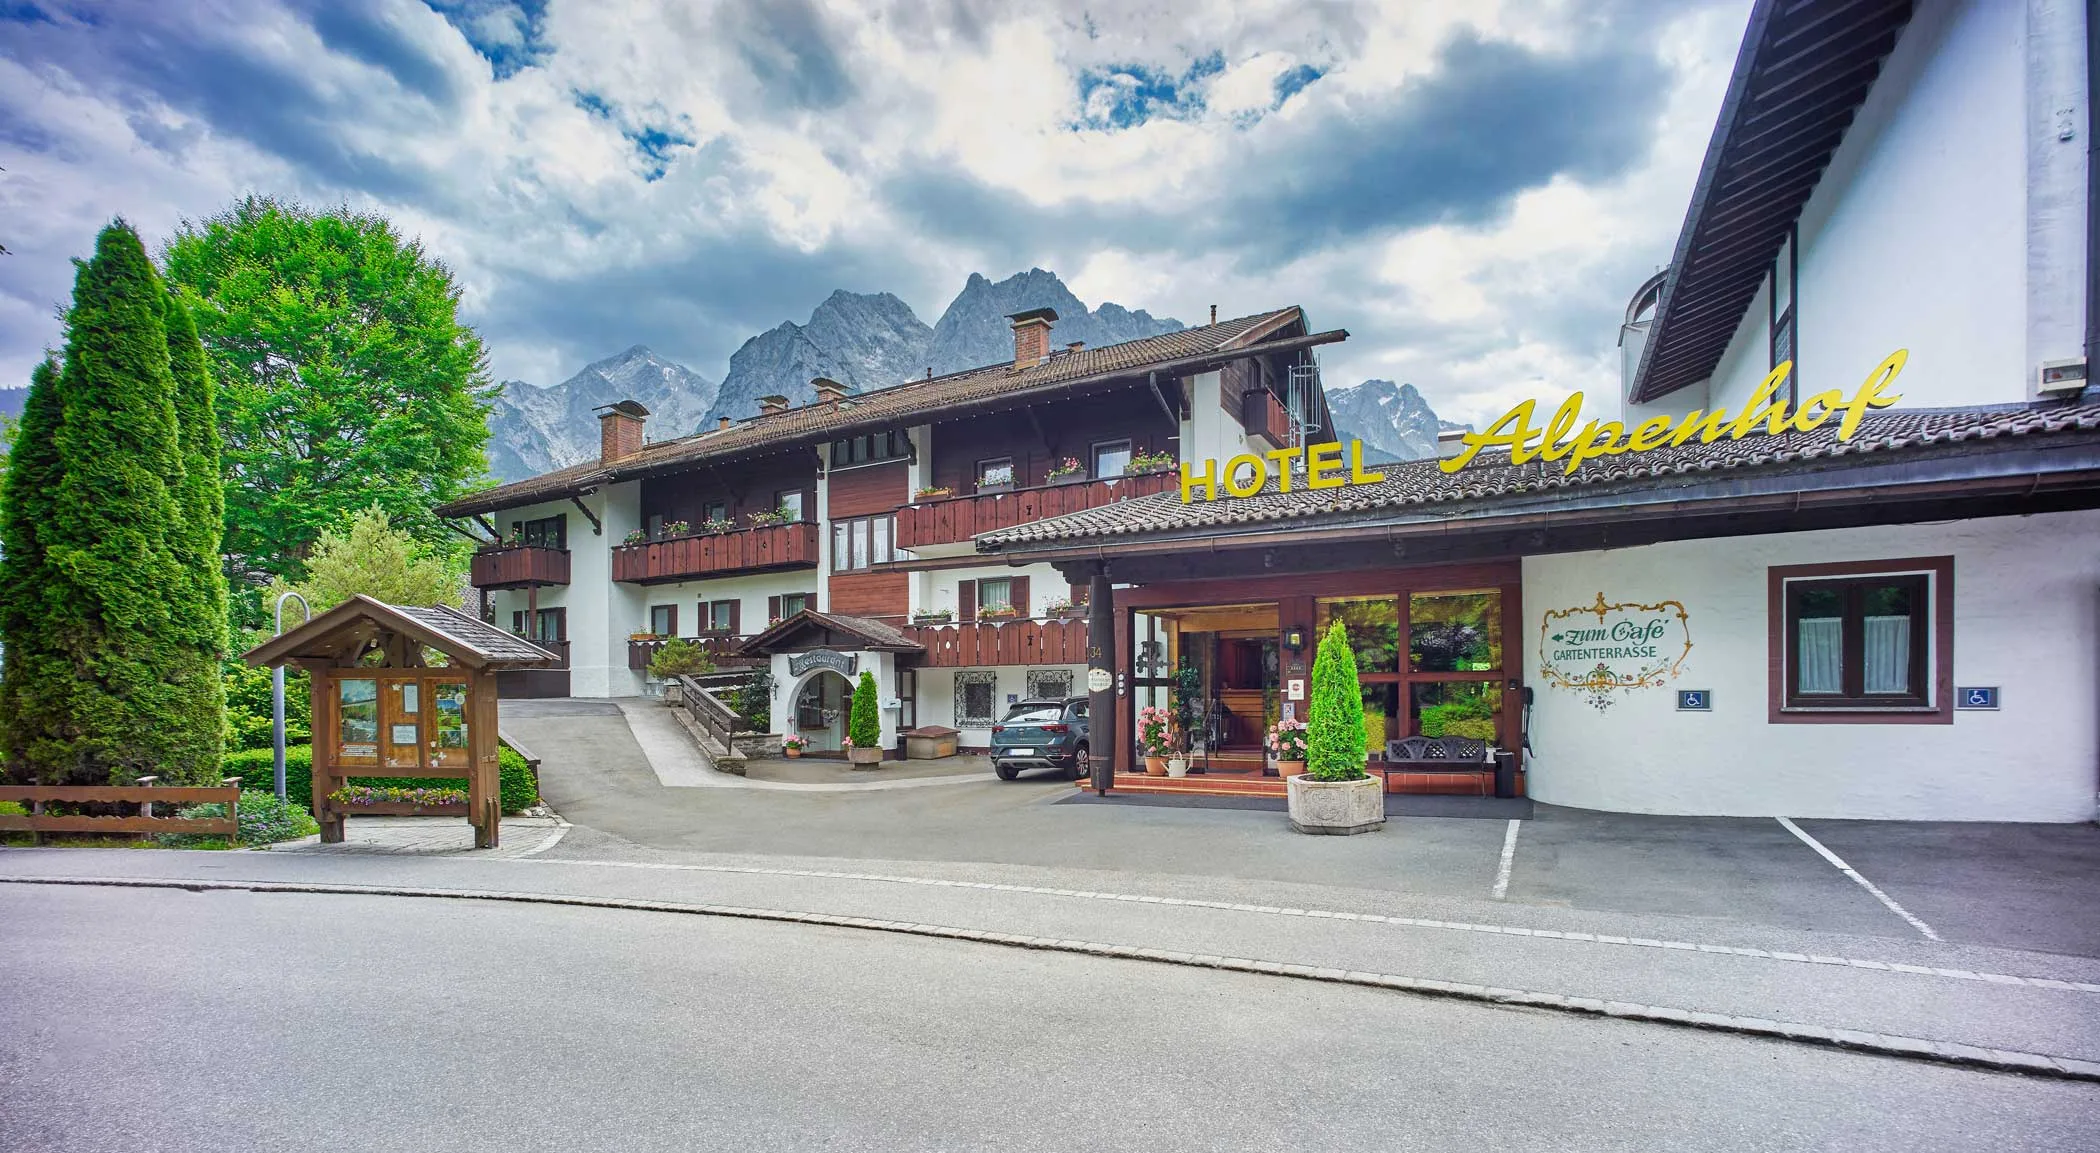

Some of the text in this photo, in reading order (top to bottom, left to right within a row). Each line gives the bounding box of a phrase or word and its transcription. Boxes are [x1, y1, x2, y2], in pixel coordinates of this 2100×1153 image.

[1181, 348, 1908, 503] HOTEL Alpenhof
[1611, 618, 1669, 646] Café
[1089, 646, 1102, 658] 34
[1553, 646, 1657, 660] GARTENTERRASSE
[798, 654, 846, 671] Restaurant
